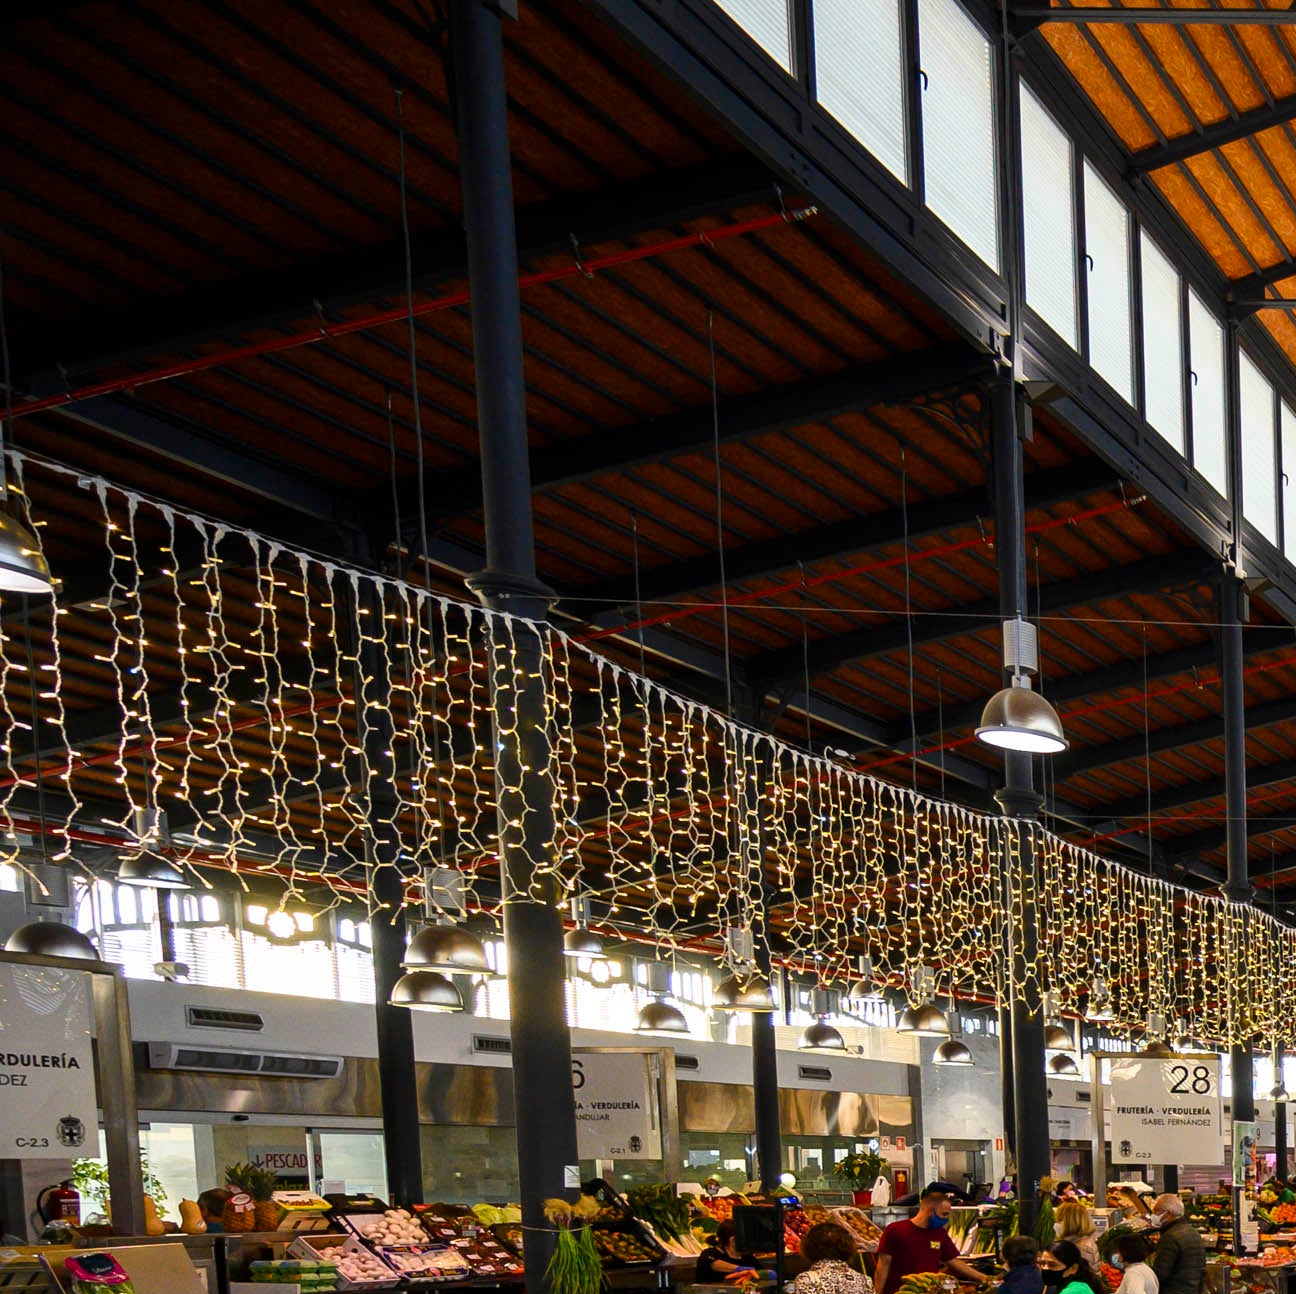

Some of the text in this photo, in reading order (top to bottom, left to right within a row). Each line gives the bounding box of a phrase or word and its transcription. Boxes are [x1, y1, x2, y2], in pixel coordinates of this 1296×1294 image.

[1170, 1065, 1211, 1095] 28
[590, 1100, 641, 1110] VERDULERÍA
[1117, 1105, 1154, 1114] FRUTERÍA
[1161, 1105, 1211, 1115] VERDULERÍA
[1141, 1117, 1211, 1126] ISABEL FERNÁNDEZ
[16, 1137, 49, 1148] C-2.3
